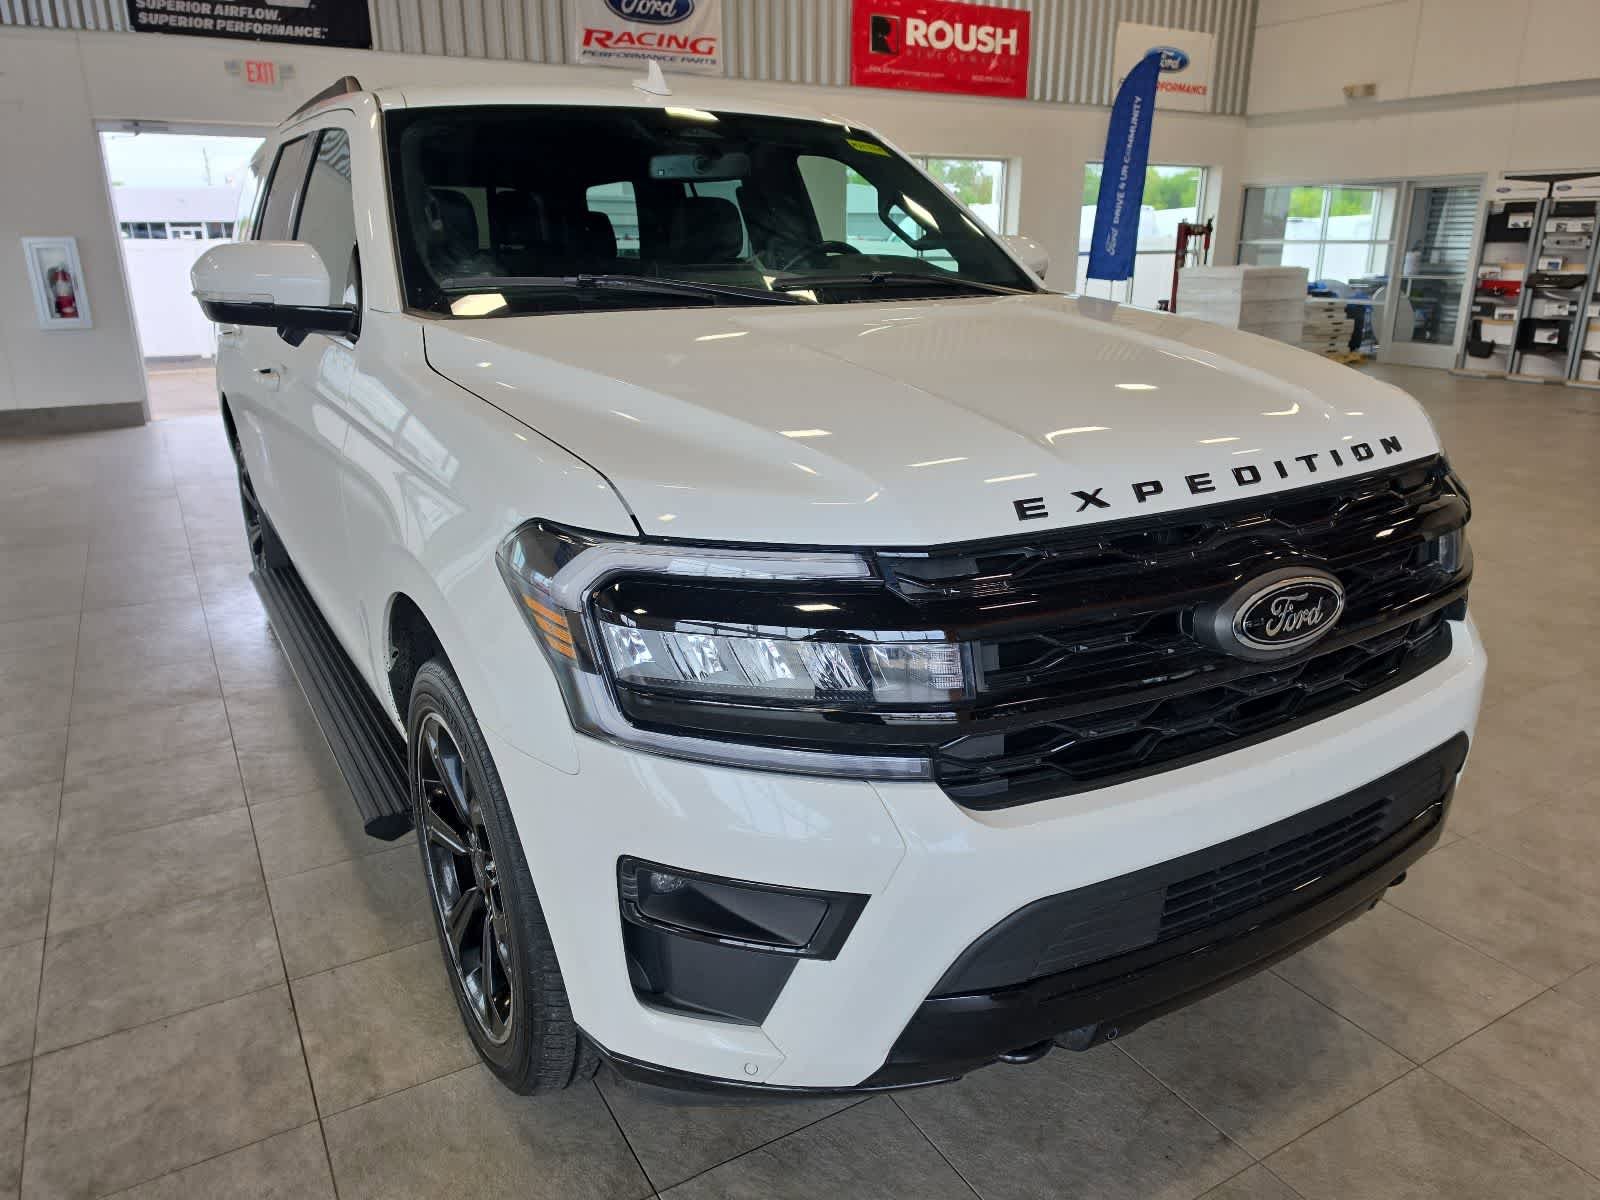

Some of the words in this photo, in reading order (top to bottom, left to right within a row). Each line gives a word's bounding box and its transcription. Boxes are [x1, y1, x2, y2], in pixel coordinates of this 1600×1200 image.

[135, 0, 212, 15] SUPERIOR
[213, 4, 282, 21] AIRFLOW.
[138, 11, 214, 30] SUPERIOR
[582, 28, 717, 56] RACING
[905, 17, 1018, 56] ROUSH
[582, 49, 675, 62] PERFORMANCE
[680, 56, 717, 64] PARTS
[245, 60, 275, 85] EXIT
[1104, 227, 1119, 257] Ford
[1113, 191, 1125, 225] DRIVE
[1121, 164, 1130, 181] UR
[1012, 435, 1403, 522] EXPEDITION
[1266, 592, 1324, 636] Ford
